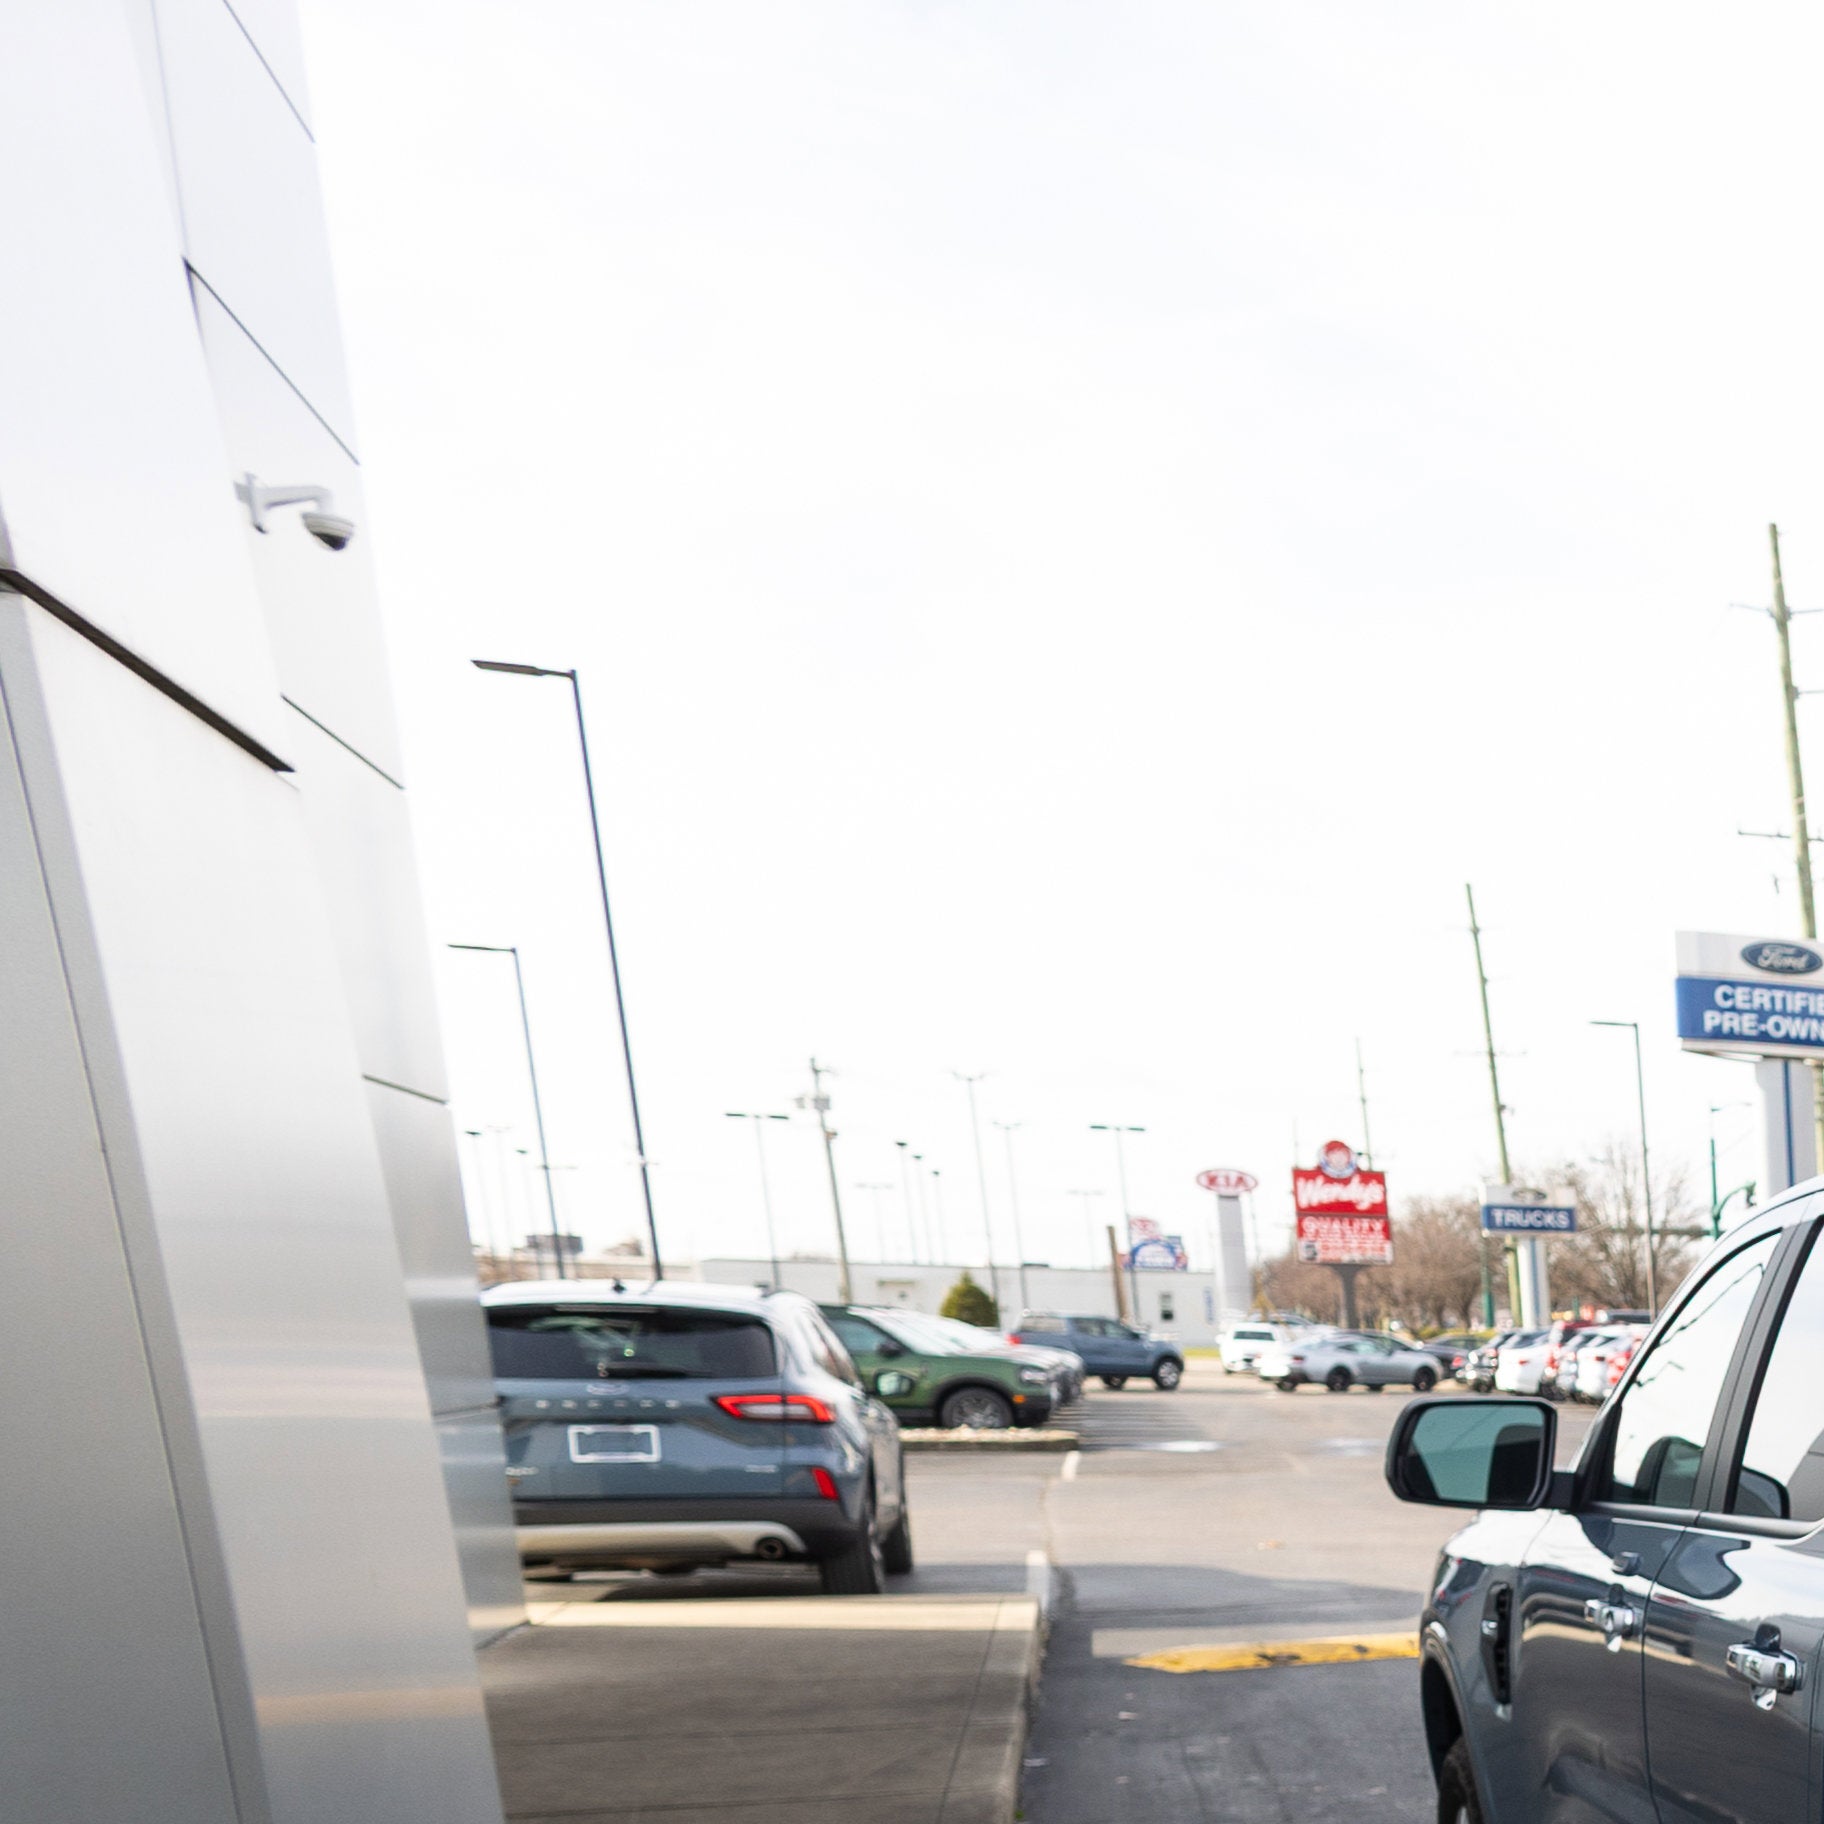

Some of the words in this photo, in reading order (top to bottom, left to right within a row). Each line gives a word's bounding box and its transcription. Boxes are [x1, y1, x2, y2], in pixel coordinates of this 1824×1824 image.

[1757, 944, 1810, 970] Ford
[1206, 1174, 1248, 1188] KIA
[1491, 1208, 1570, 1229] TRUCKS
